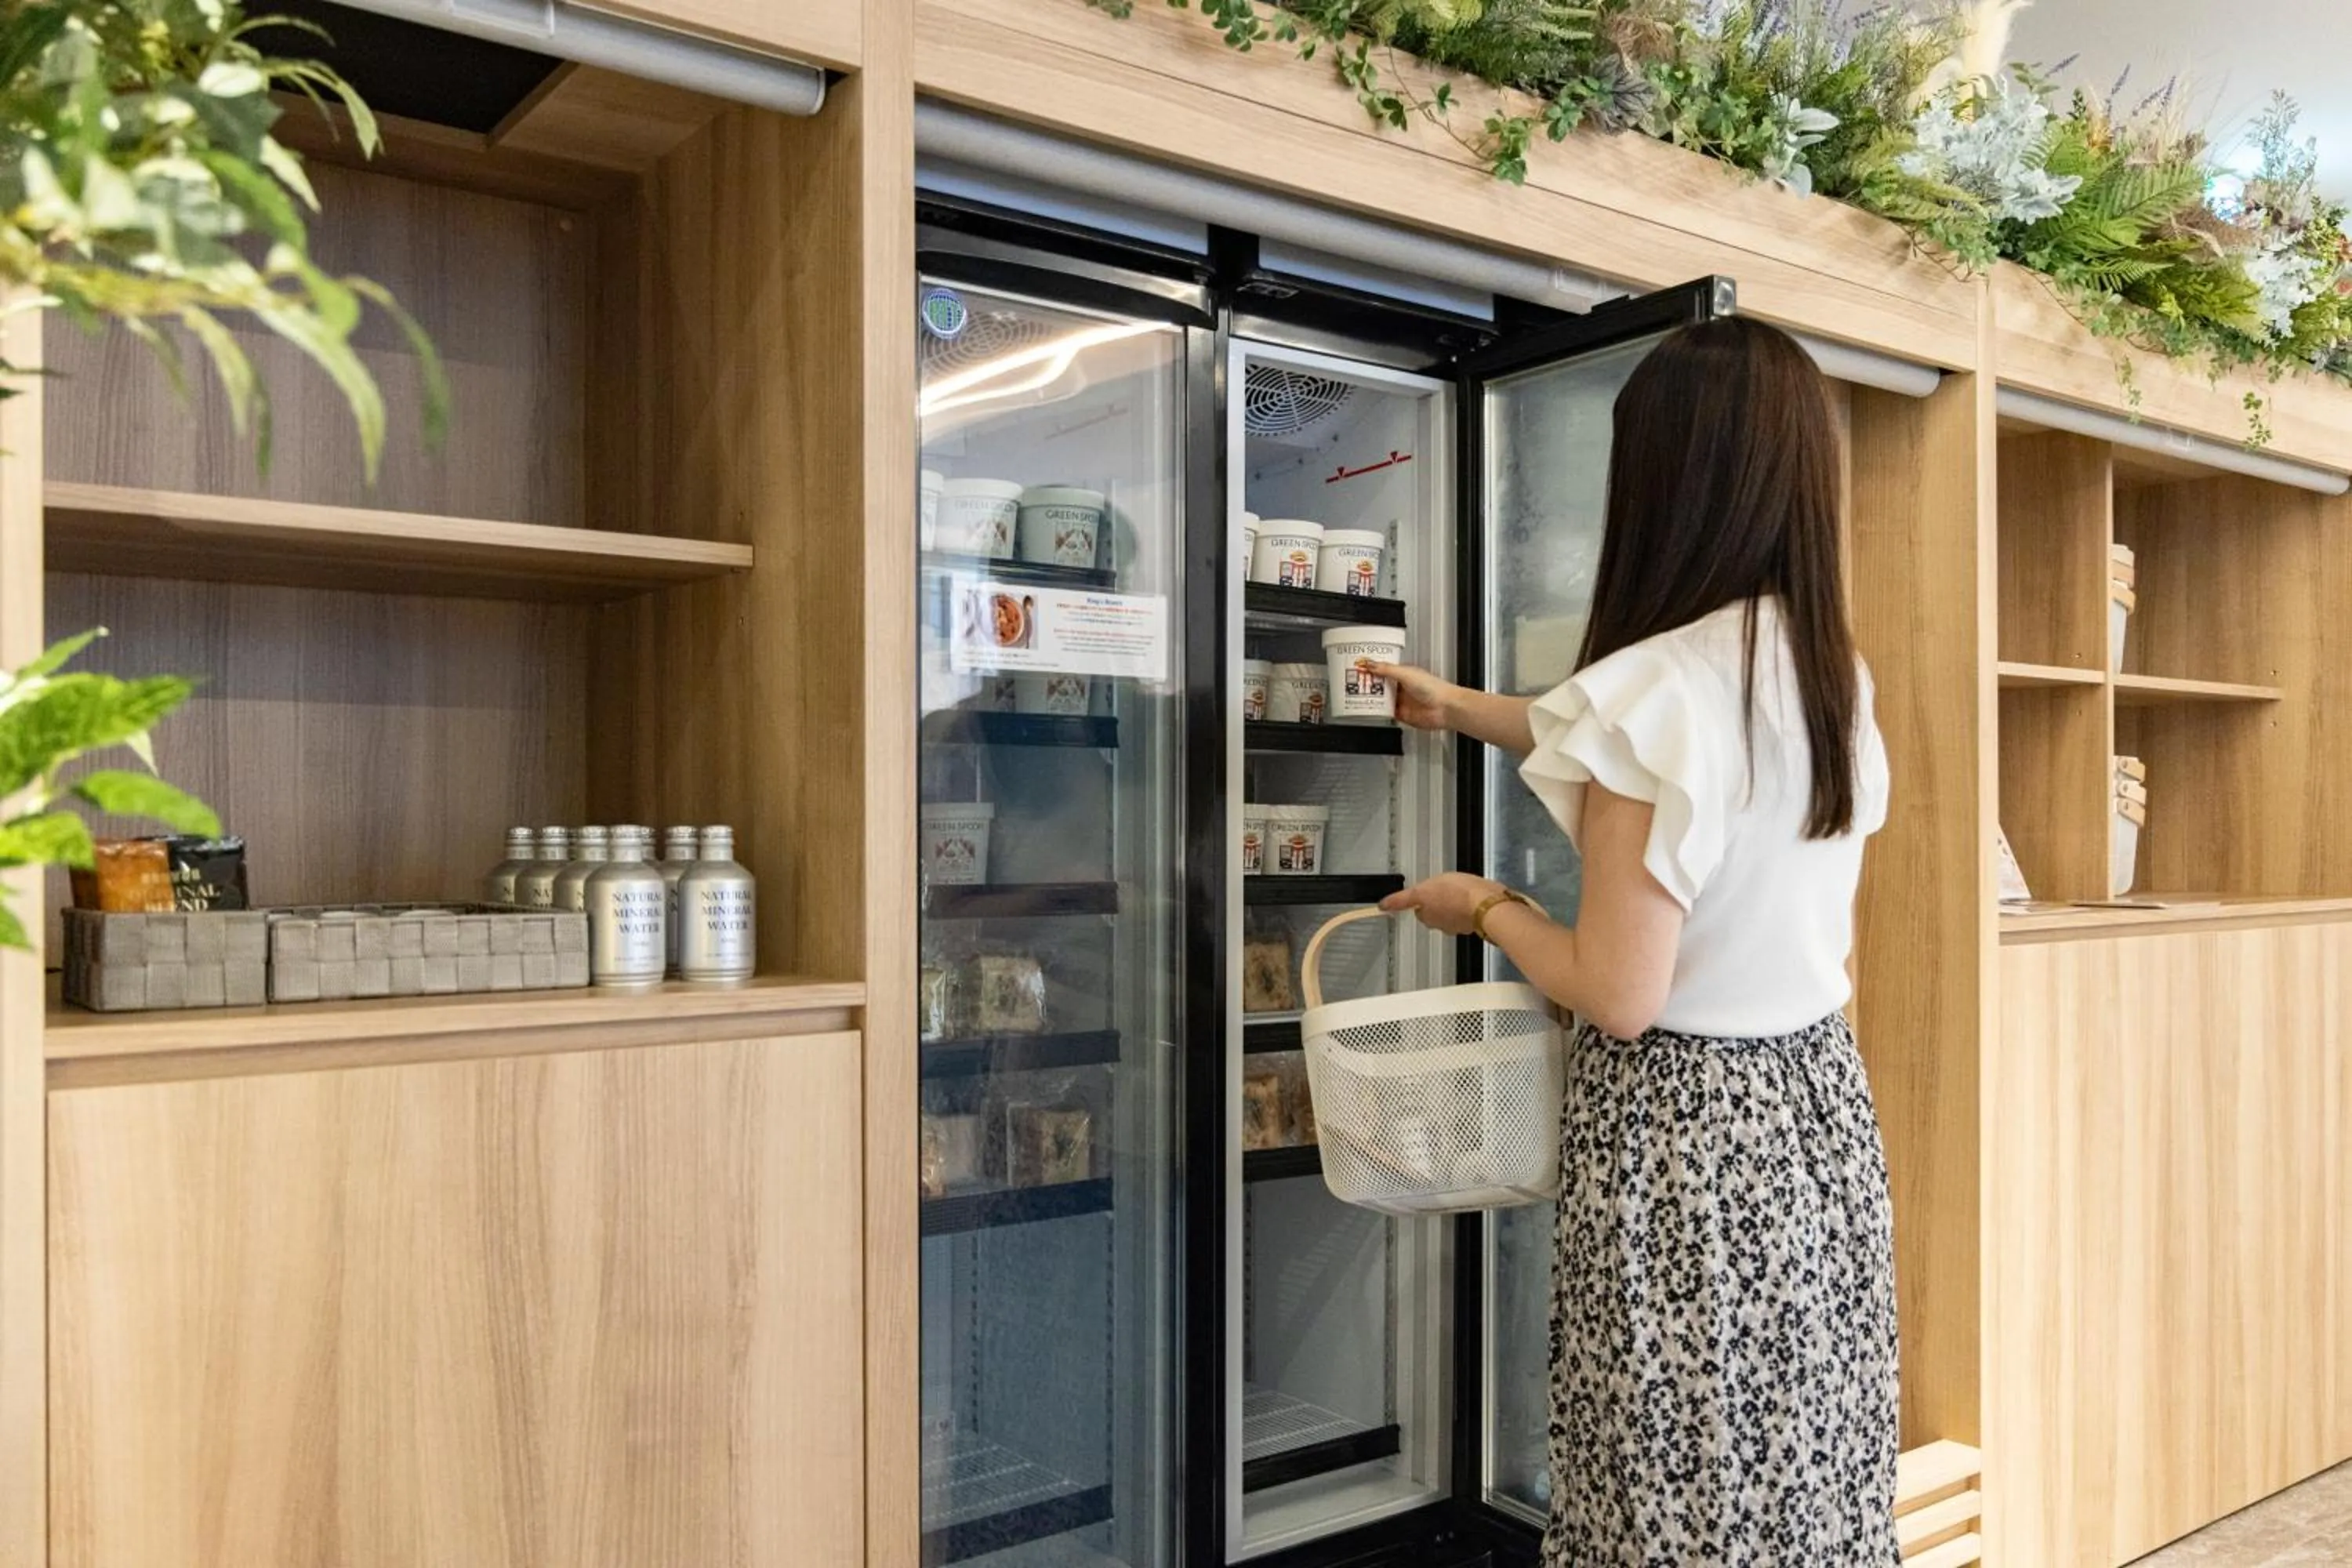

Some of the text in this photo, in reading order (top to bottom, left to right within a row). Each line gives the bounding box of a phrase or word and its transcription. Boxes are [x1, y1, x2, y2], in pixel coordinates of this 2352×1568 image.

[1271, 539, 1301, 547] GREEN
[1337, 645, 1393, 654] GREEN SPOON
[619, 923, 659, 934] WATER
[708, 920, 748, 930] WATER
